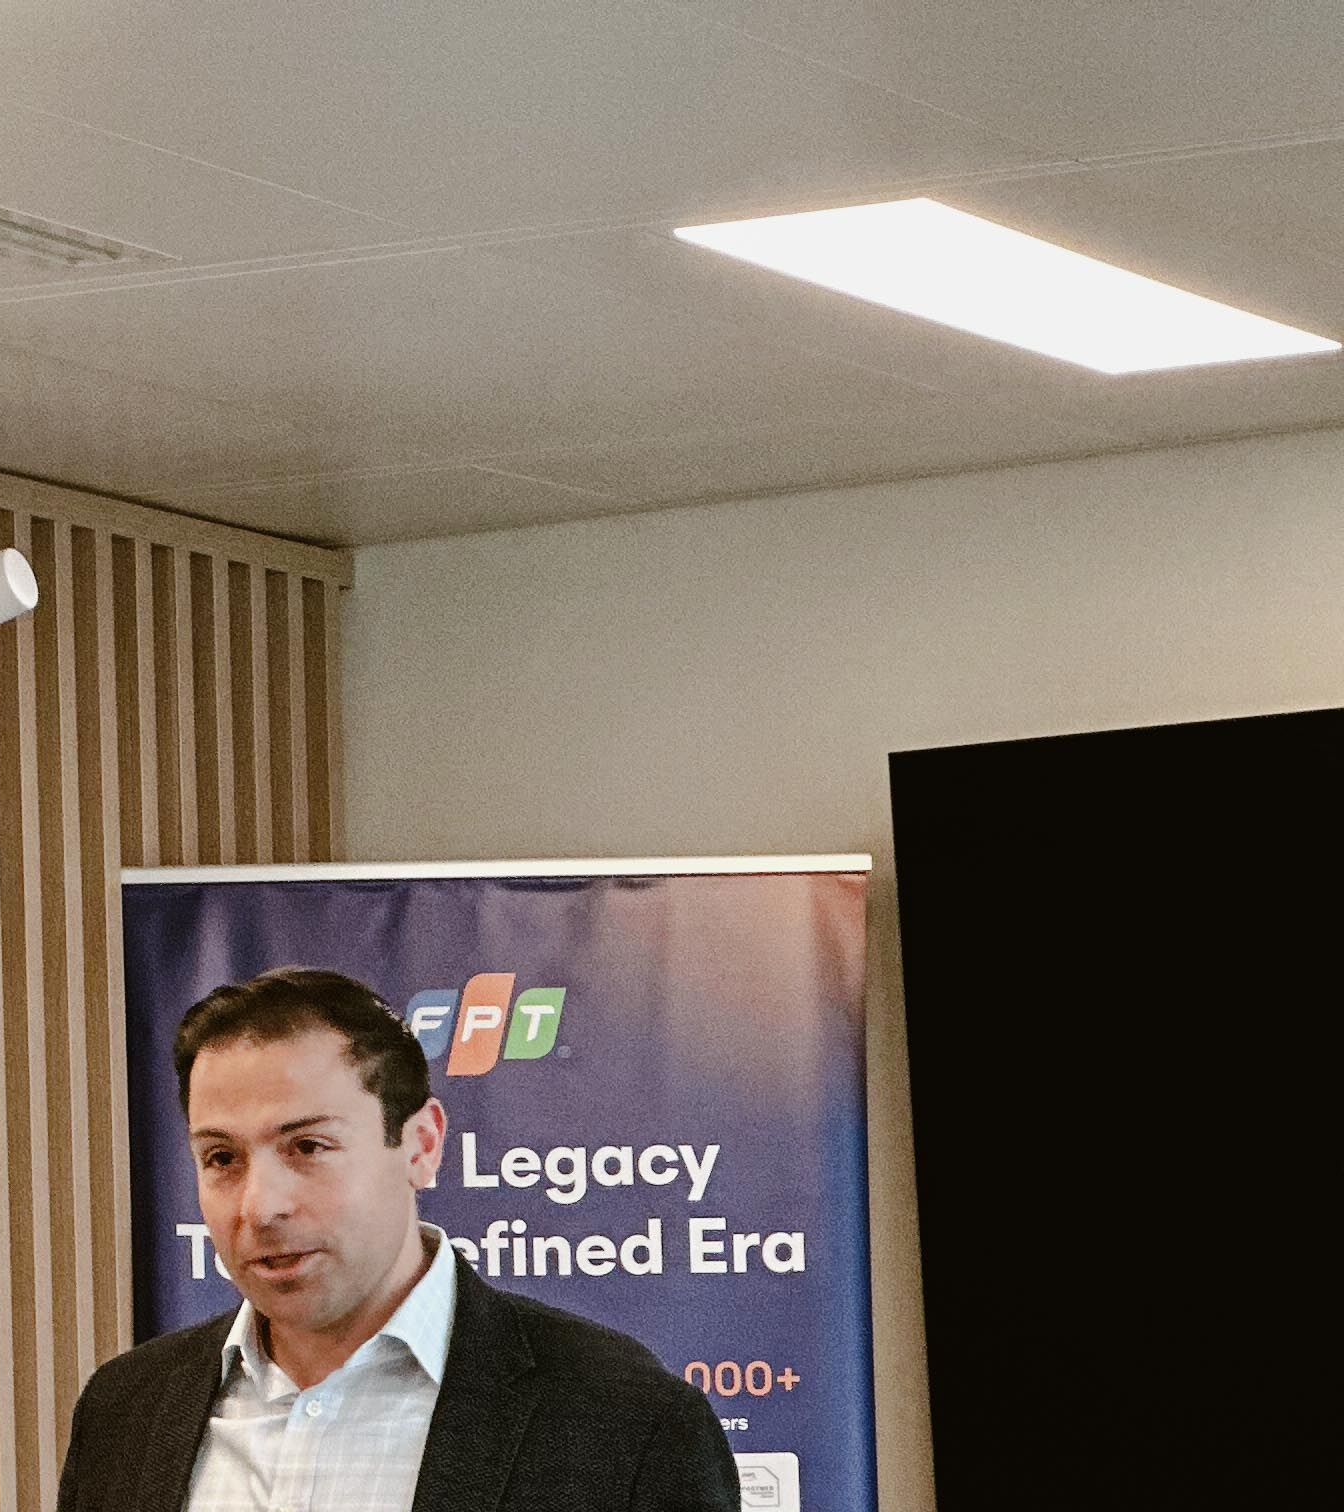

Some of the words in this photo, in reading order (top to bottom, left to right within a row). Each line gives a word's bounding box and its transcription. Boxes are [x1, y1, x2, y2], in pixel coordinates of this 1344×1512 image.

[413, 1005, 555, 1042] FPT
[462, 1131, 720, 1204] Legacy
[176, 1223, 232, 1281] T
[688, 1217, 807, 1275] Era
